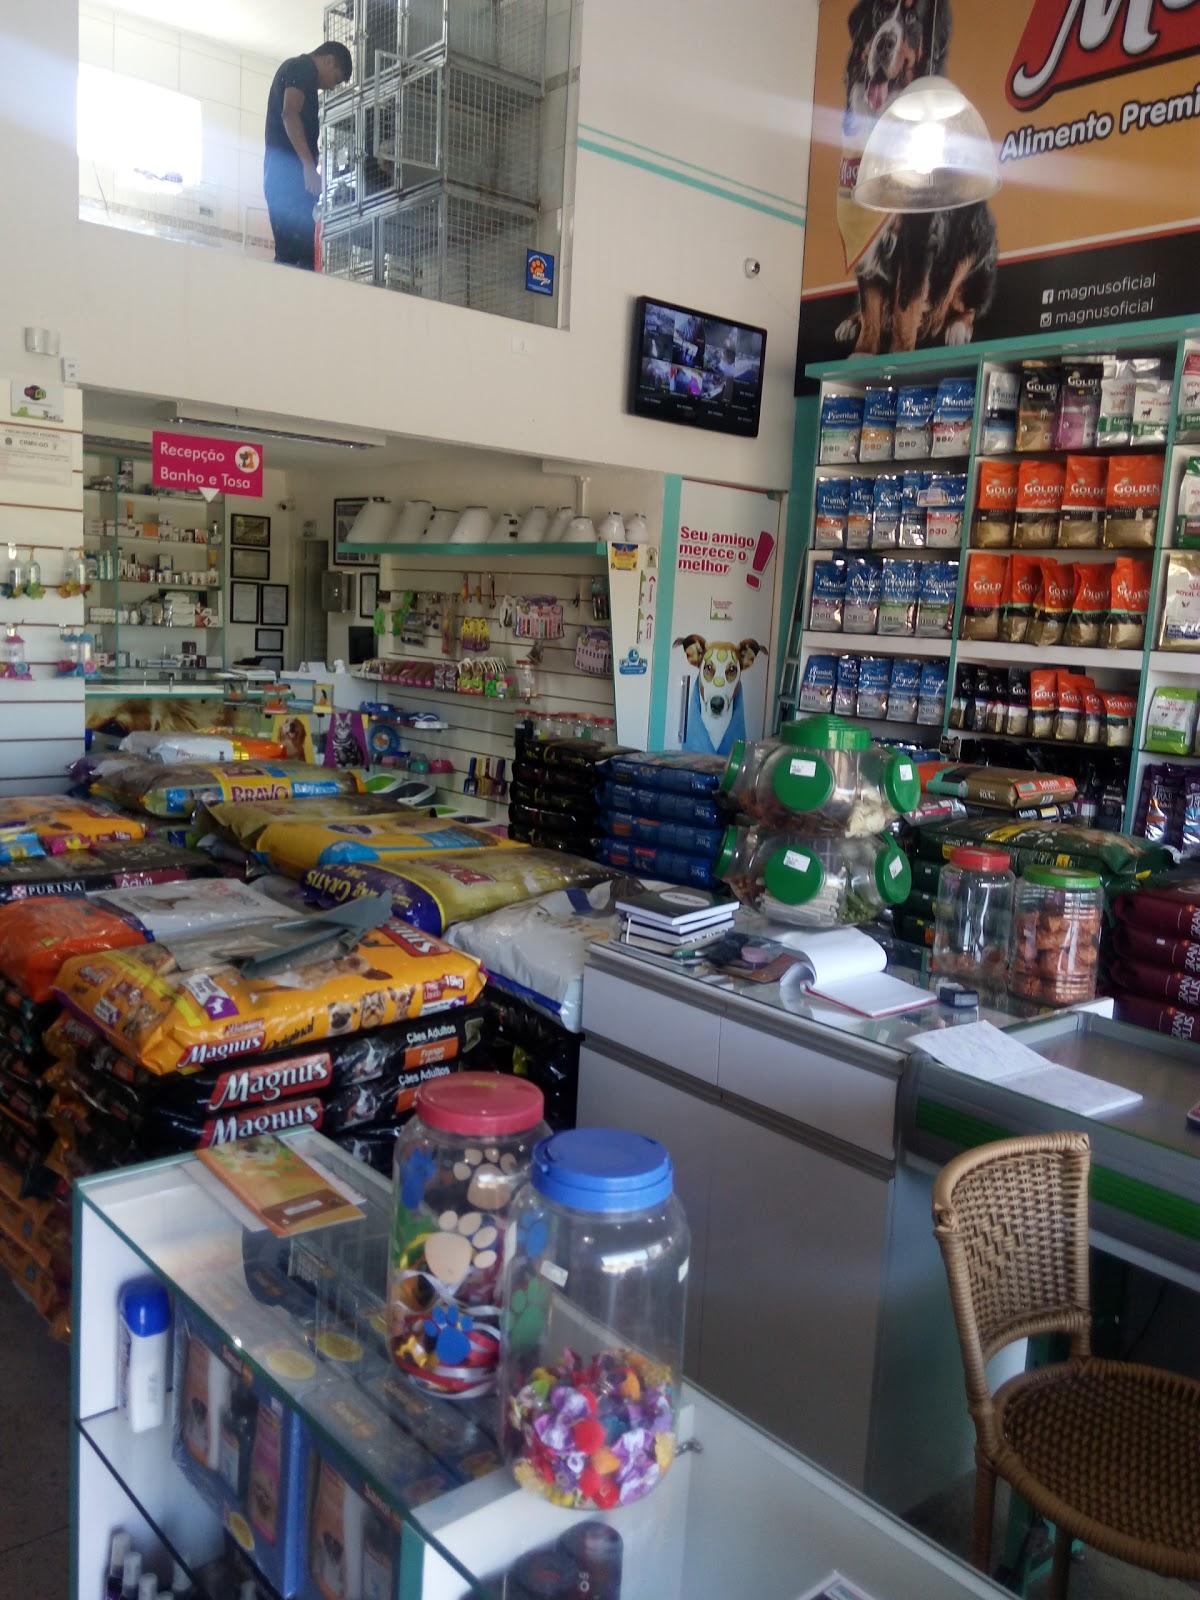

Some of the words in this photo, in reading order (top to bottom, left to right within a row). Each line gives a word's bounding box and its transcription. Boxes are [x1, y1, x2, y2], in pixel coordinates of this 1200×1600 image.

[1000, 112, 1112, 161] Alimento
[1121, 83, 1200, 132] Premi
[1058, 272, 1156, 301] magnusoficial
[1055, 297, 1154, 324] magnusoficial
[160, 441, 225, 463] Recepção
[160, 466, 205, 484] Banho
[208, 475, 218, 485] e
[221, 473, 251, 489] Tosa
[1113, 483, 1160, 495] GOLDEN
[680, 526, 708, 541] Seu
[711, 532, 755, 549] amigo
[679, 544, 735, 560] merece
[738, 550, 747, 562] o
[678, 559, 731, 574] melhor
[973, 581, 1001, 592] GOLD
[28, 882, 83, 897] PURINA
[427, 1025, 457, 1040] Adultos
[177, 1034, 261, 1069] Magnus
[420, 1066, 450, 1080] Adultos
[208, 1061, 328, 1111] Magnus
[210, 1104, 319, 1147] Magnus
